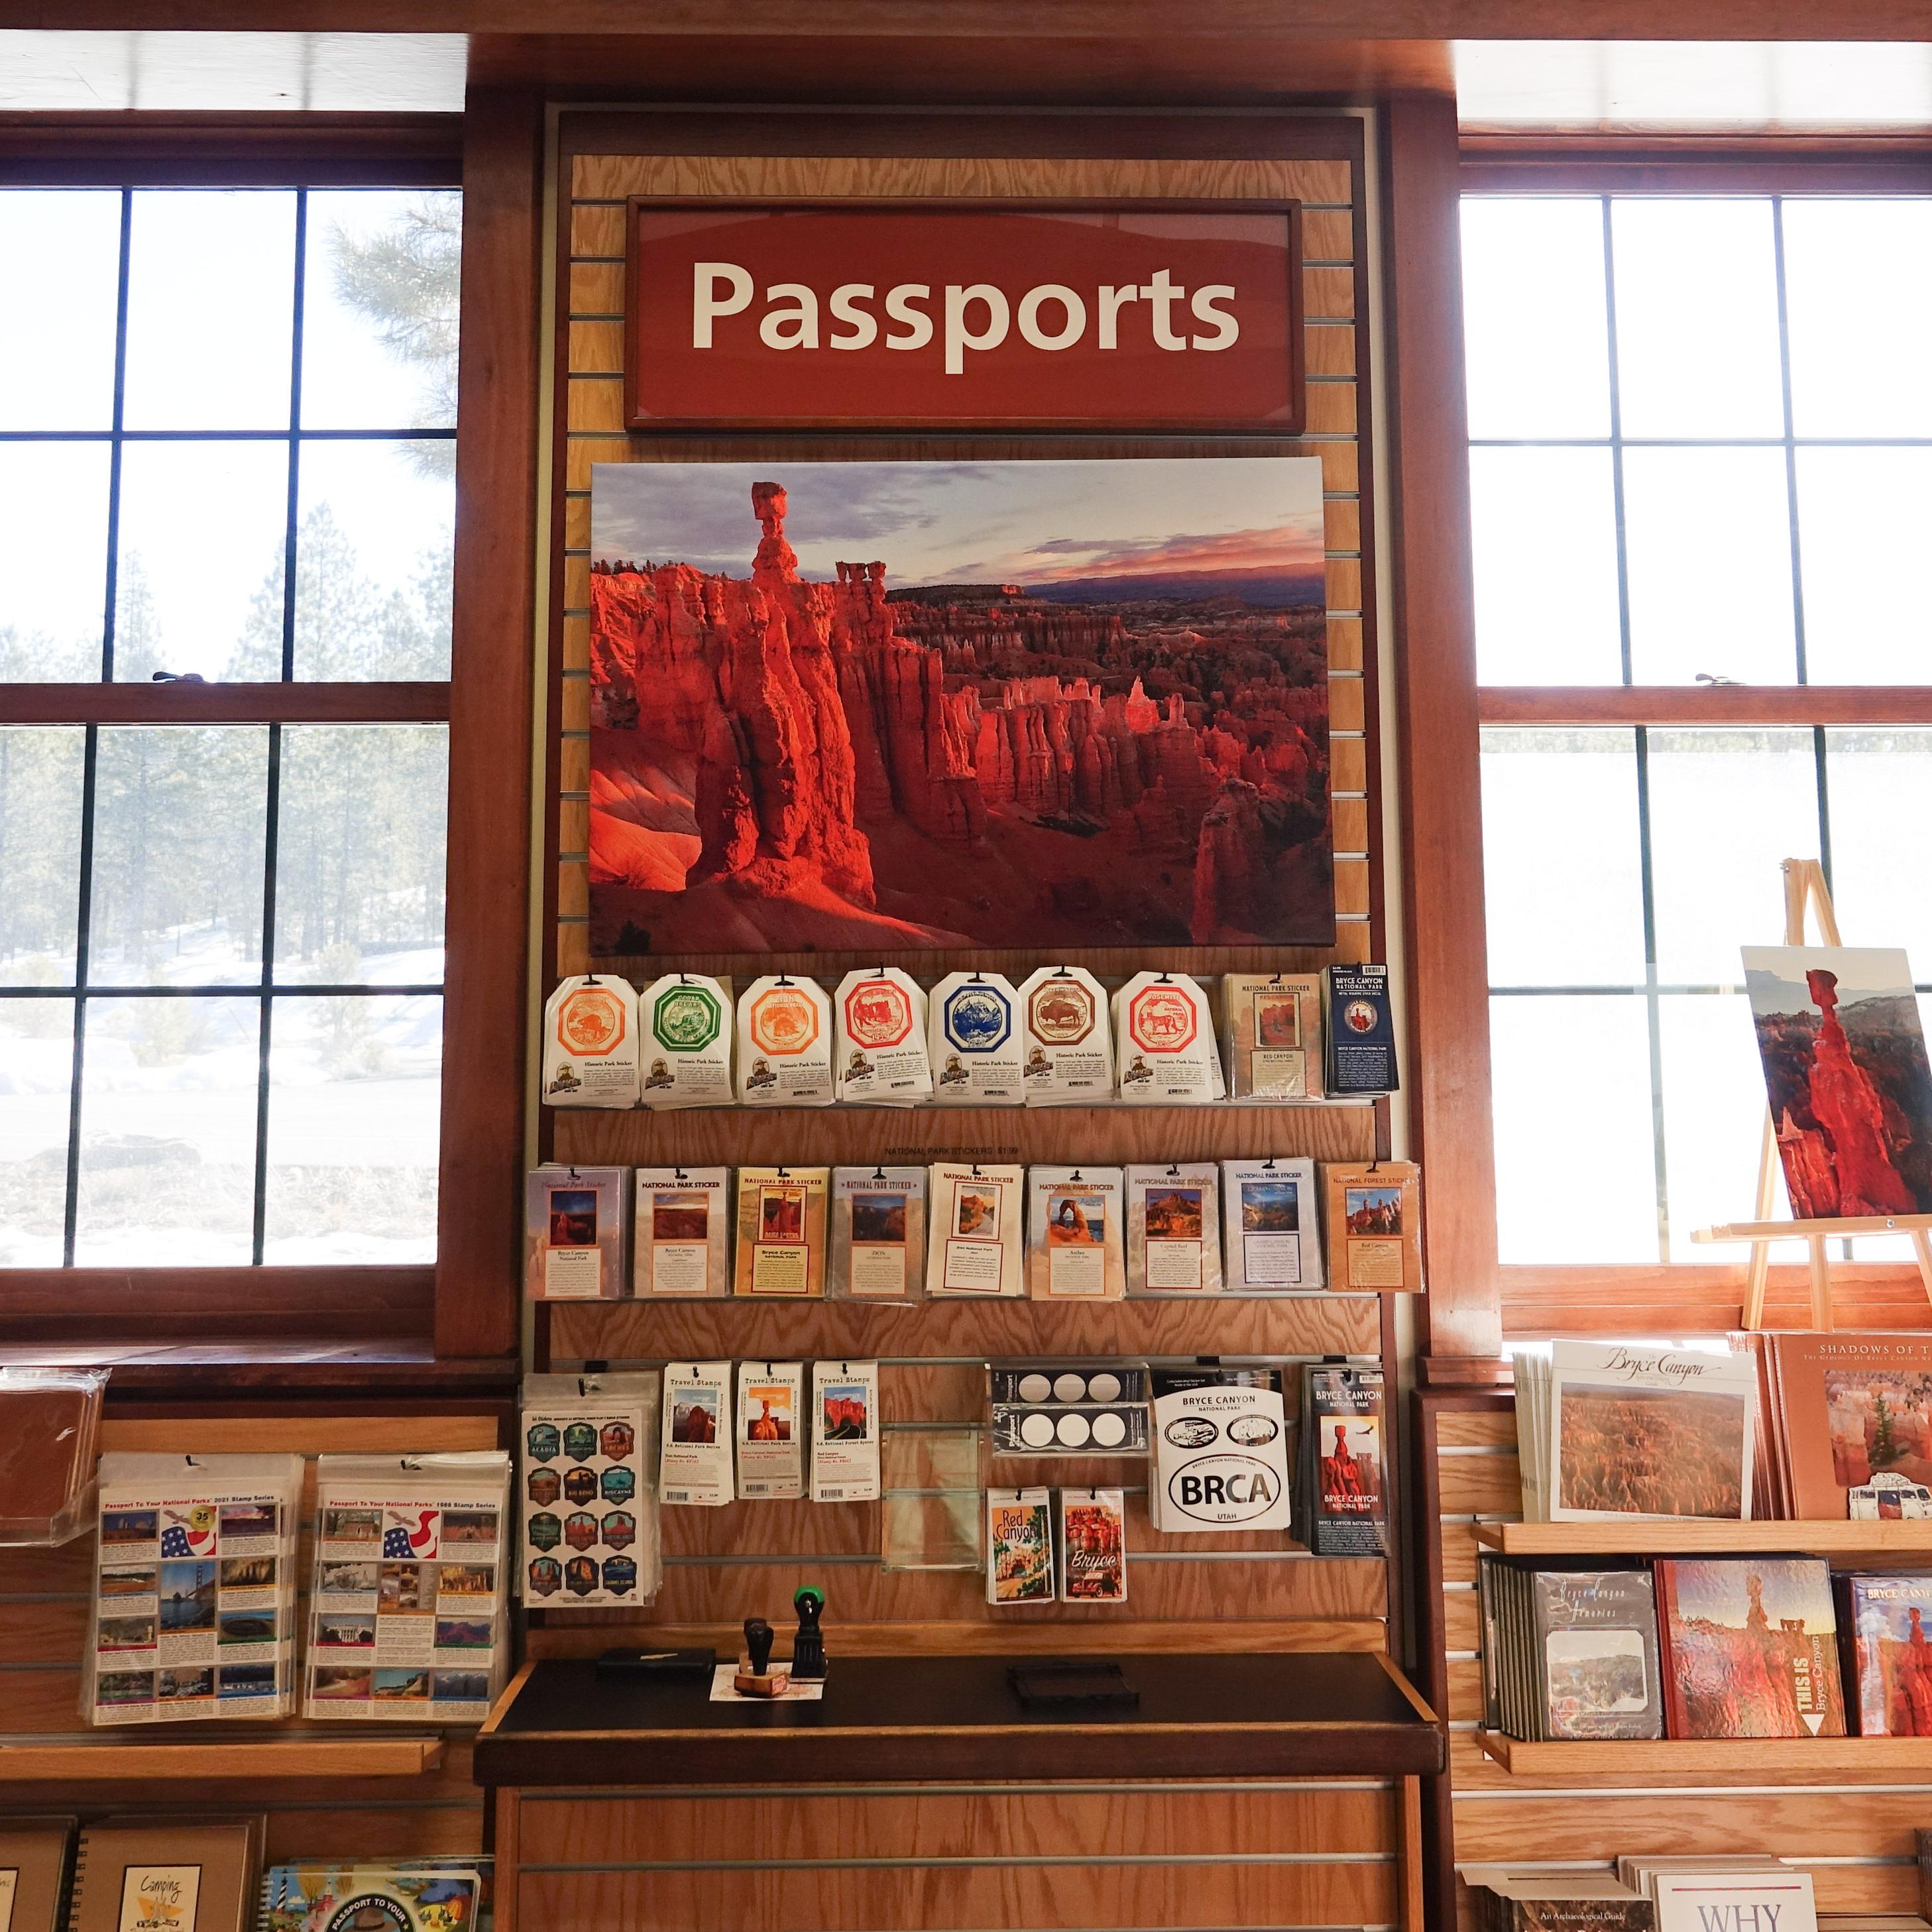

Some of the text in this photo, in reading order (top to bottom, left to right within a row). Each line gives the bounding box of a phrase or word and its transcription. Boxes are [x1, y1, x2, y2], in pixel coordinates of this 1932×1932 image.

[693, 262, 1239, 374] Passports
[1820, 1345, 1914, 1354] SHADOWS OF
[1596, 1346, 1721, 1386] Bryce Canyon
[1216, 1396, 1255, 1404] CANYON
[1316, 1391, 1382, 1400] BRYCE CANYON
[1181, 1473, 1272, 1505] BRCA
[1003, 1510, 1023, 1527] Red
[996, 1524, 1036, 1542] Canyon
[1071, 1550, 1116, 1571] Bryce
[1560, 1578, 1625, 1602] Bryce Canyon
[1868, 1589, 1898, 1599] BRYCE
[1793, 1658, 1813, 1711] THIS IS
[1812, 1636, 1827, 1711] Bryce Canyon
[141, 1875, 183, 1904] Camping
[332, 1898, 371, 1930] PASSPORT
[387, 1901, 406, 1922] YOUR
[1553, 1912, 1603, 1921] Archaeological
[1605, 1912, 1626, 1921] Guide
[1697, 1904, 1782, 1932] WHY
